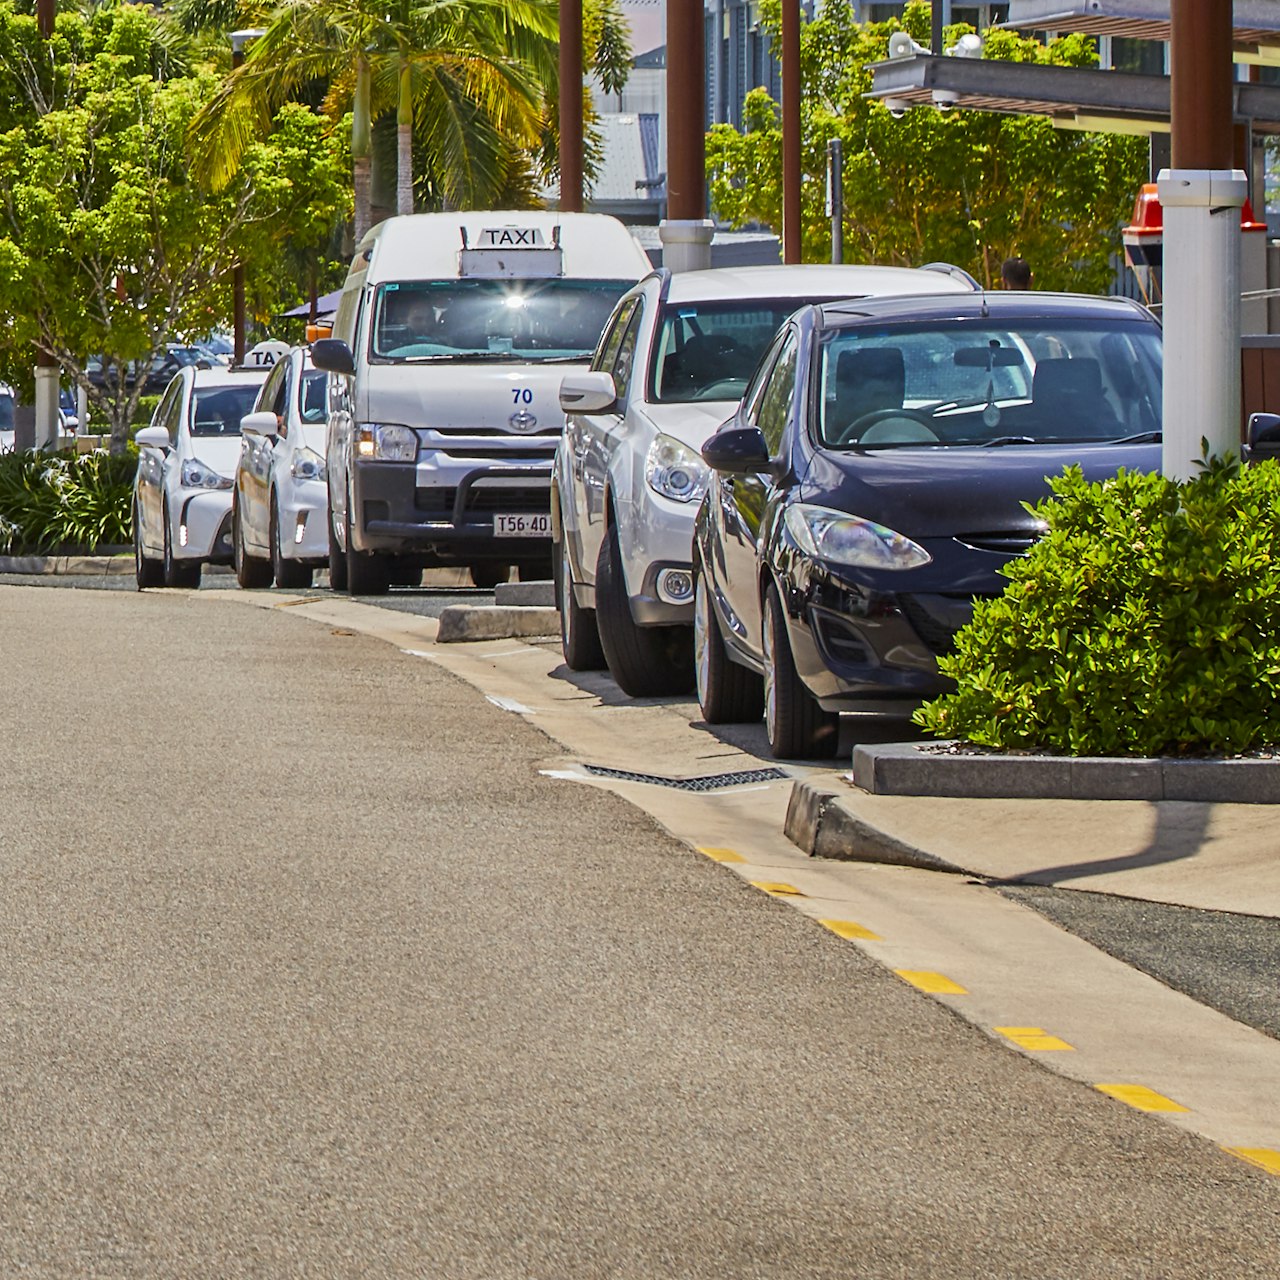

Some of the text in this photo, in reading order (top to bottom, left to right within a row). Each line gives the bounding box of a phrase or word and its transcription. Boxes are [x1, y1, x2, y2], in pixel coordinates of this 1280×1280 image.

[485, 229, 536, 245] TAXI
[252, 351, 282, 365] TA
[511, 388, 533, 404] 70
